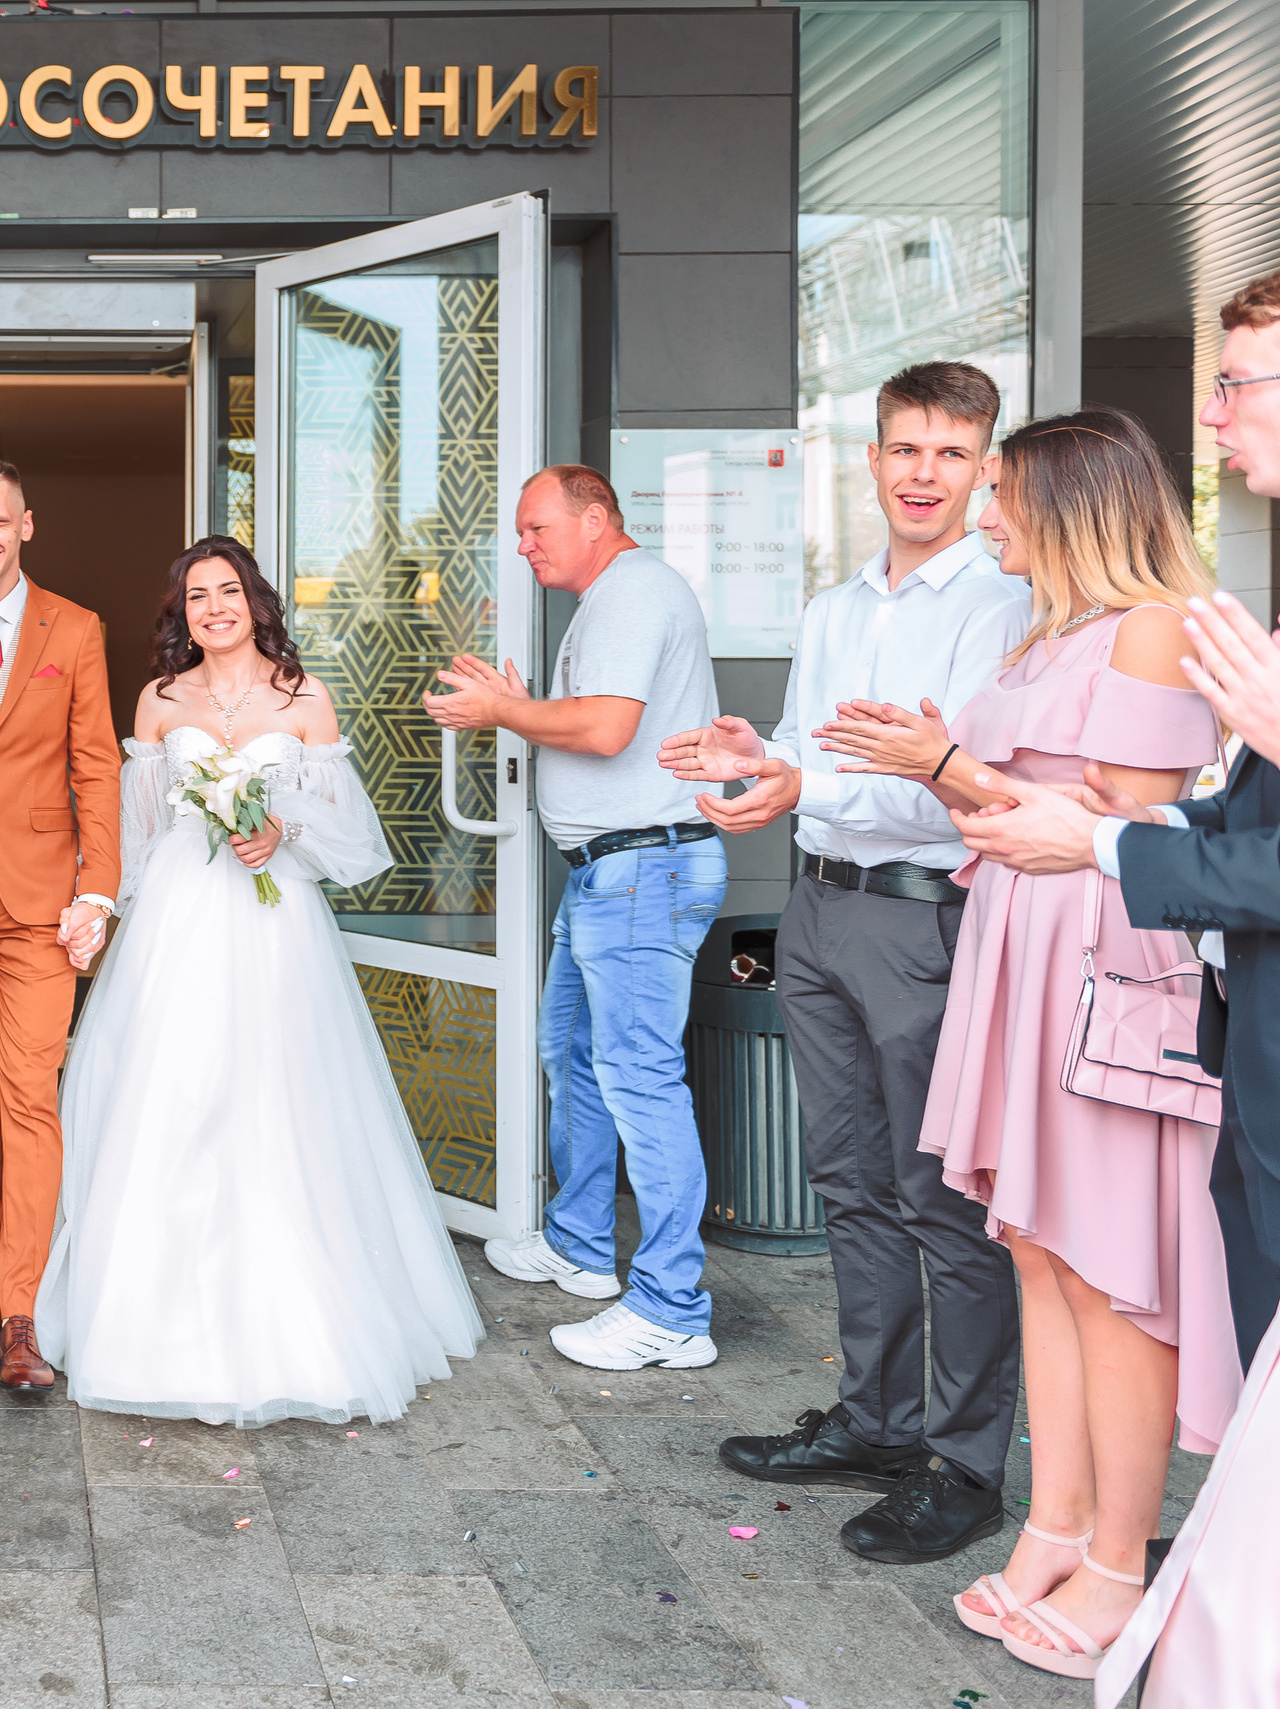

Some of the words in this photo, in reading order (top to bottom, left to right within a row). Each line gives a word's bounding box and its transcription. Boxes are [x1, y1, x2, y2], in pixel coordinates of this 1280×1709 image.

[630, 523, 676, 535] РЕЖИМ
[678, 523, 725, 535] РАБОТЫ
[715, 541, 742, 553] 9:00
[754, 541, 785, 553] 18:00
[710, 562, 742, 574] 10:00
[754, 562, 785, 574] 19:00
